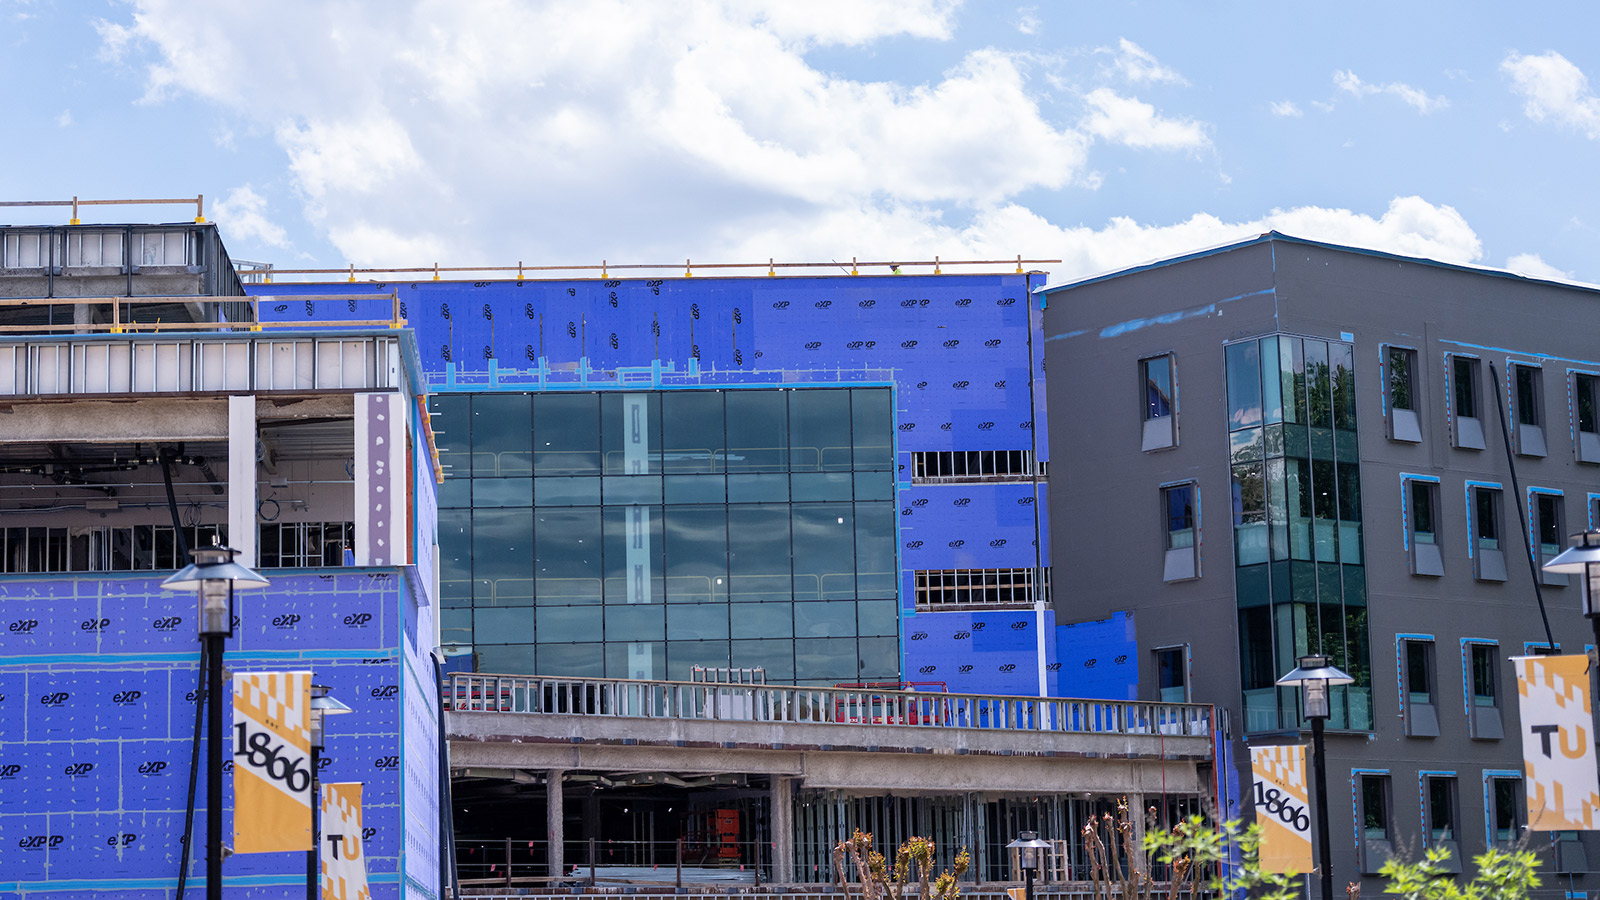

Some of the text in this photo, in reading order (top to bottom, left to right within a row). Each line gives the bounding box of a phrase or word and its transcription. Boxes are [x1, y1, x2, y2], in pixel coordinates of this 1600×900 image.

[604, 280, 621, 288] eXP
[647, 280, 663, 288] eXP
[610, 291, 618, 308] eXP
[773, 301, 790, 309] eXP
[815, 300, 832, 308] eXP
[901, 299, 918, 307] eXP
[306, 300, 314, 317] eXP
[400, 302, 408, 319] eXP
[442, 303, 450, 320] eXP
[692, 303, 700, 320] eXP
[734, 308, 742, 325] eXP
[568, 322, 577, 339] eXP
[611, 333, 619, 349] eXP
[901, 340, 918, 348] eXP
[943, 340, 959, 348] eXP
[985, 339, 1001, 347] eXP
[442, 345, 450, 361] eXP
[527, 345, 535, 361] eXP
[735, 349, 743, 366] eXP
[953, 381, 969, 389] eXP
[995, 380, 1006, 388] eX
[978, 422, 995, 430] eXP
[954, 498, 971, 506] eXP
[1018, 497, 1034, 505] eXP
[949, 540, 965, 548] eXP
[990, 539, 1007, 547] eXP
[81, 618, 111, 630] eXP
[153, 616, 182, 628] eXP
[272, 614, 301, 626] eXP
[344, 613, 372, 626] eXP
[1011, 621, 1028, 629] eXP
[9, 620, 38, 632] eXP
[1115, 655, 1127, 664] eXP
[1046, 663, 1062, 671] eXP
[113, 690, 141, 702] eXP
[371, 685, 399, 698] eXP
[41, 692, 69, 705] eXP
[1531, 724, 1587, 760] TU
[234, 721, 310, 793] 1866
[0, 764, 21, 777] XP
[65, 763, 94, 775] eXP
[138, 761, 167, 774] eXP
[1253, 781, 1310, 832] 1866
[19, 835, 48, 848] eXP
[327, 834, 360, 861] TU
